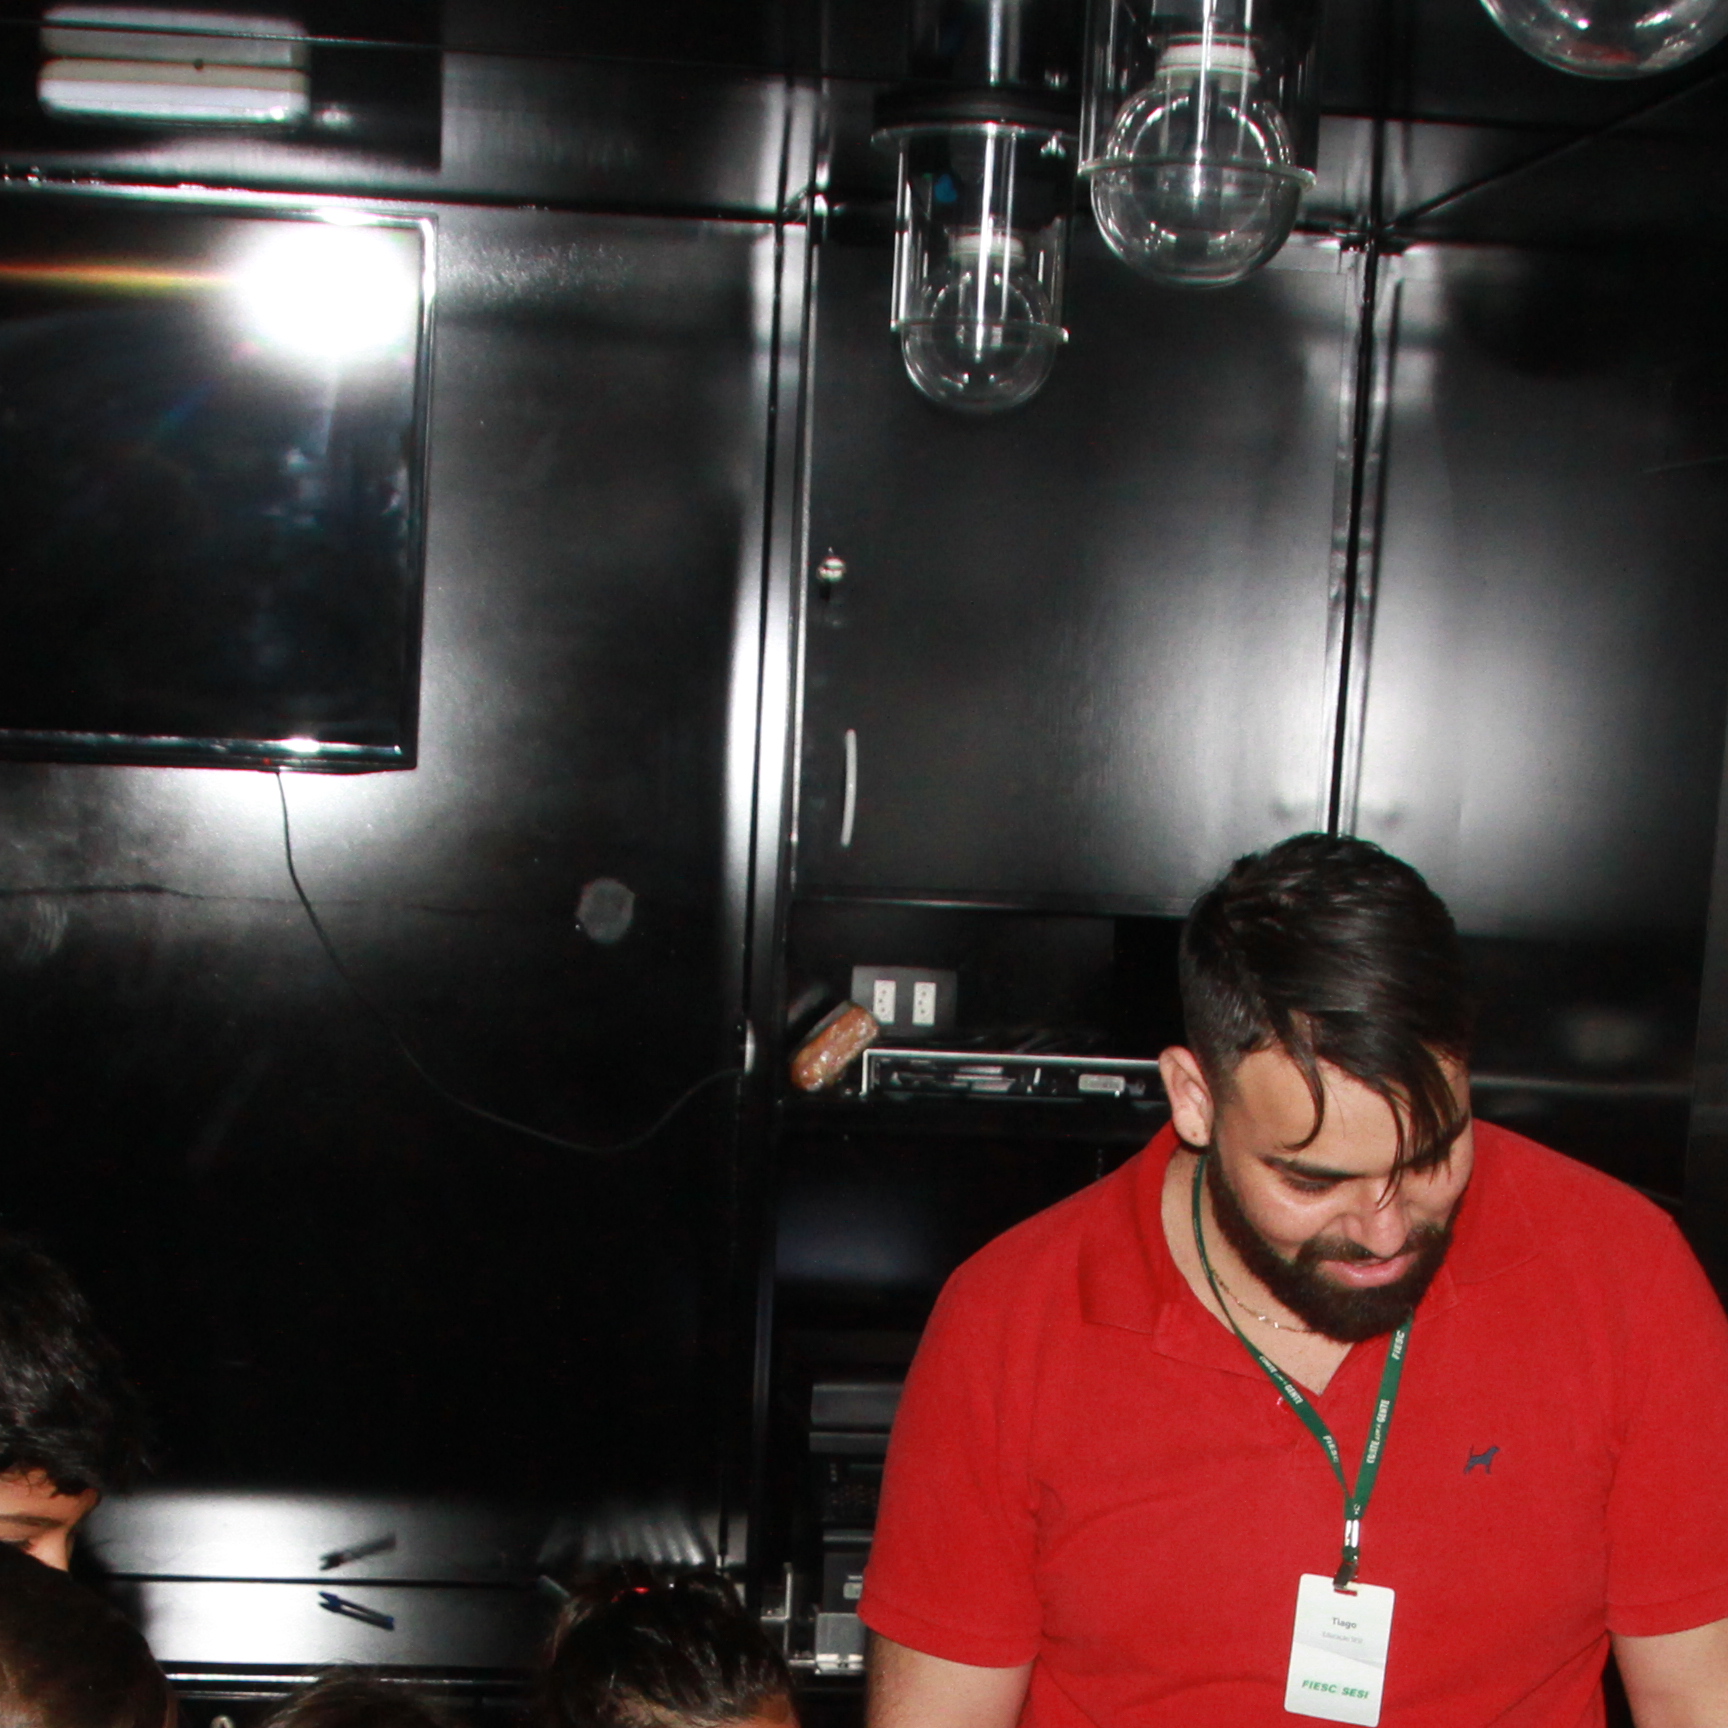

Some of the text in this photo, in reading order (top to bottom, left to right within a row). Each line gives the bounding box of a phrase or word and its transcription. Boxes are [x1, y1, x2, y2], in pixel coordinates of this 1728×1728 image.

[1392, 1330, 1405, 1360] FIESC
[1332, 1617, 1357, 1629] Tiago
[1302, 1680, 1370, 1699] FIESC SESI
